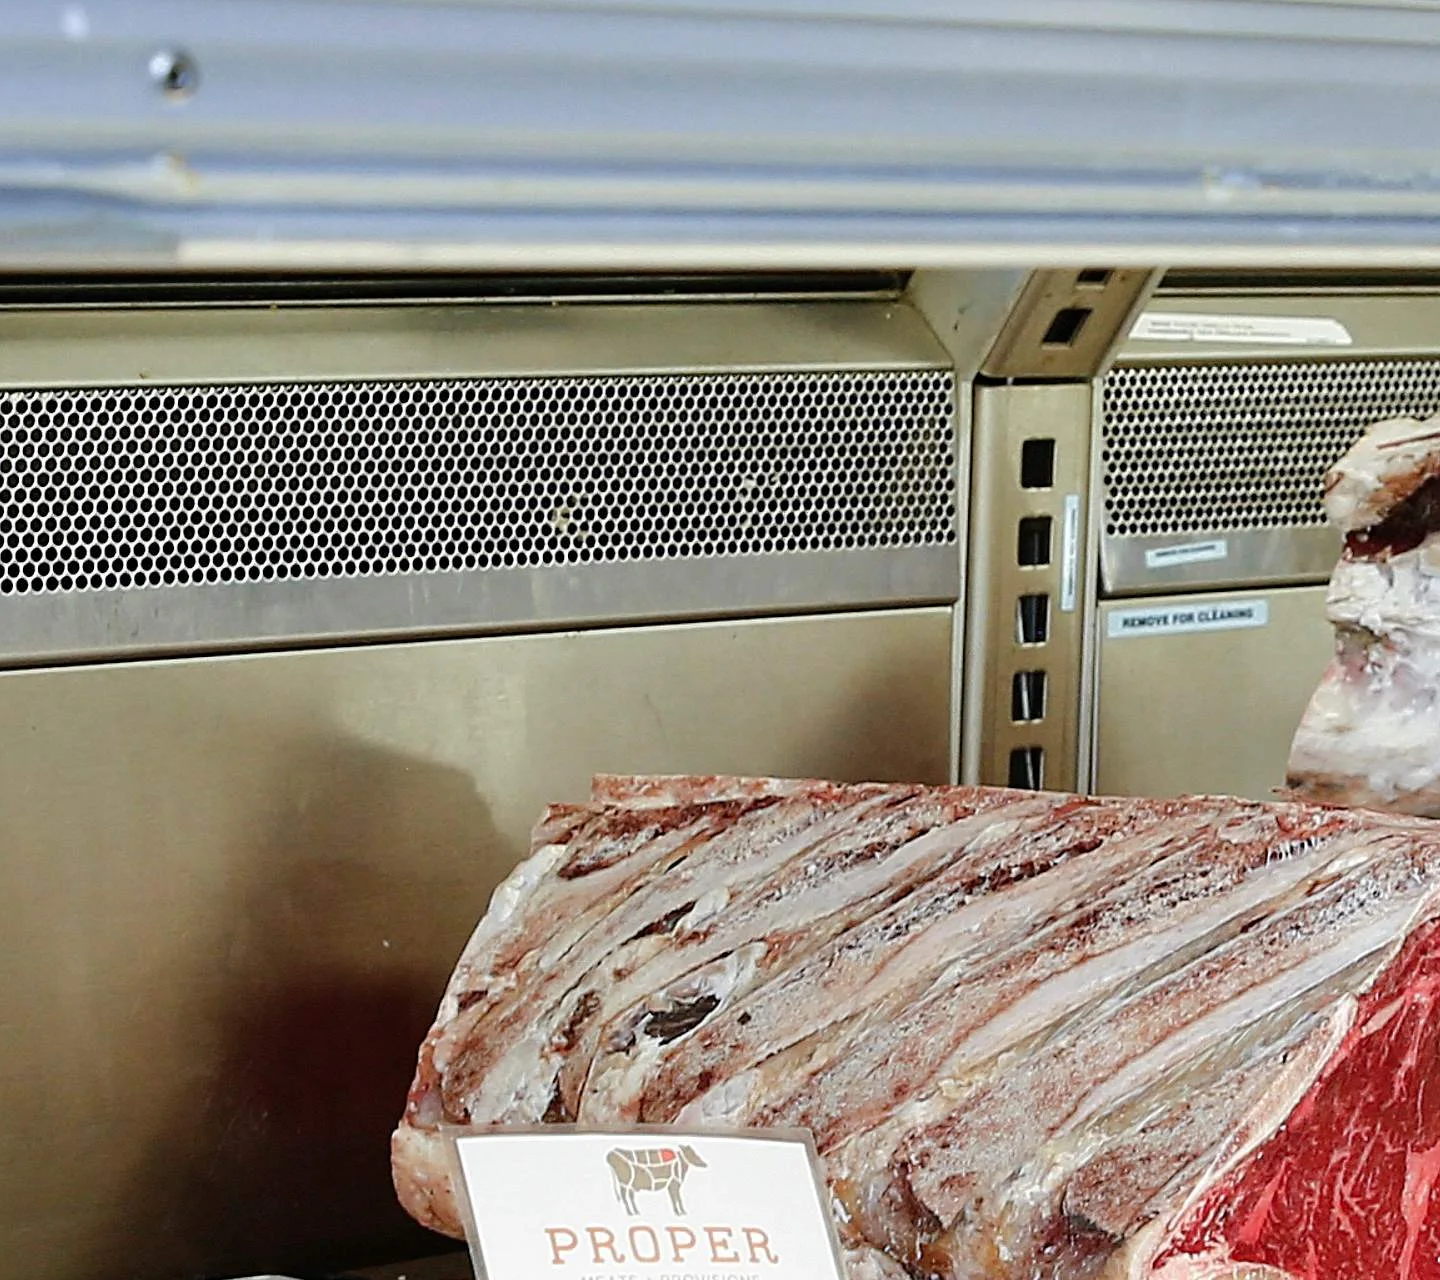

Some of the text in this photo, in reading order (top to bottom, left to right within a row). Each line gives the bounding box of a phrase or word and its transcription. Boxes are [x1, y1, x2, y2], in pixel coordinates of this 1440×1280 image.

[1122, 608, 1254, 629] REMOVE FOR CLEANING
[544, 1225, 780, 1266] PROPER
